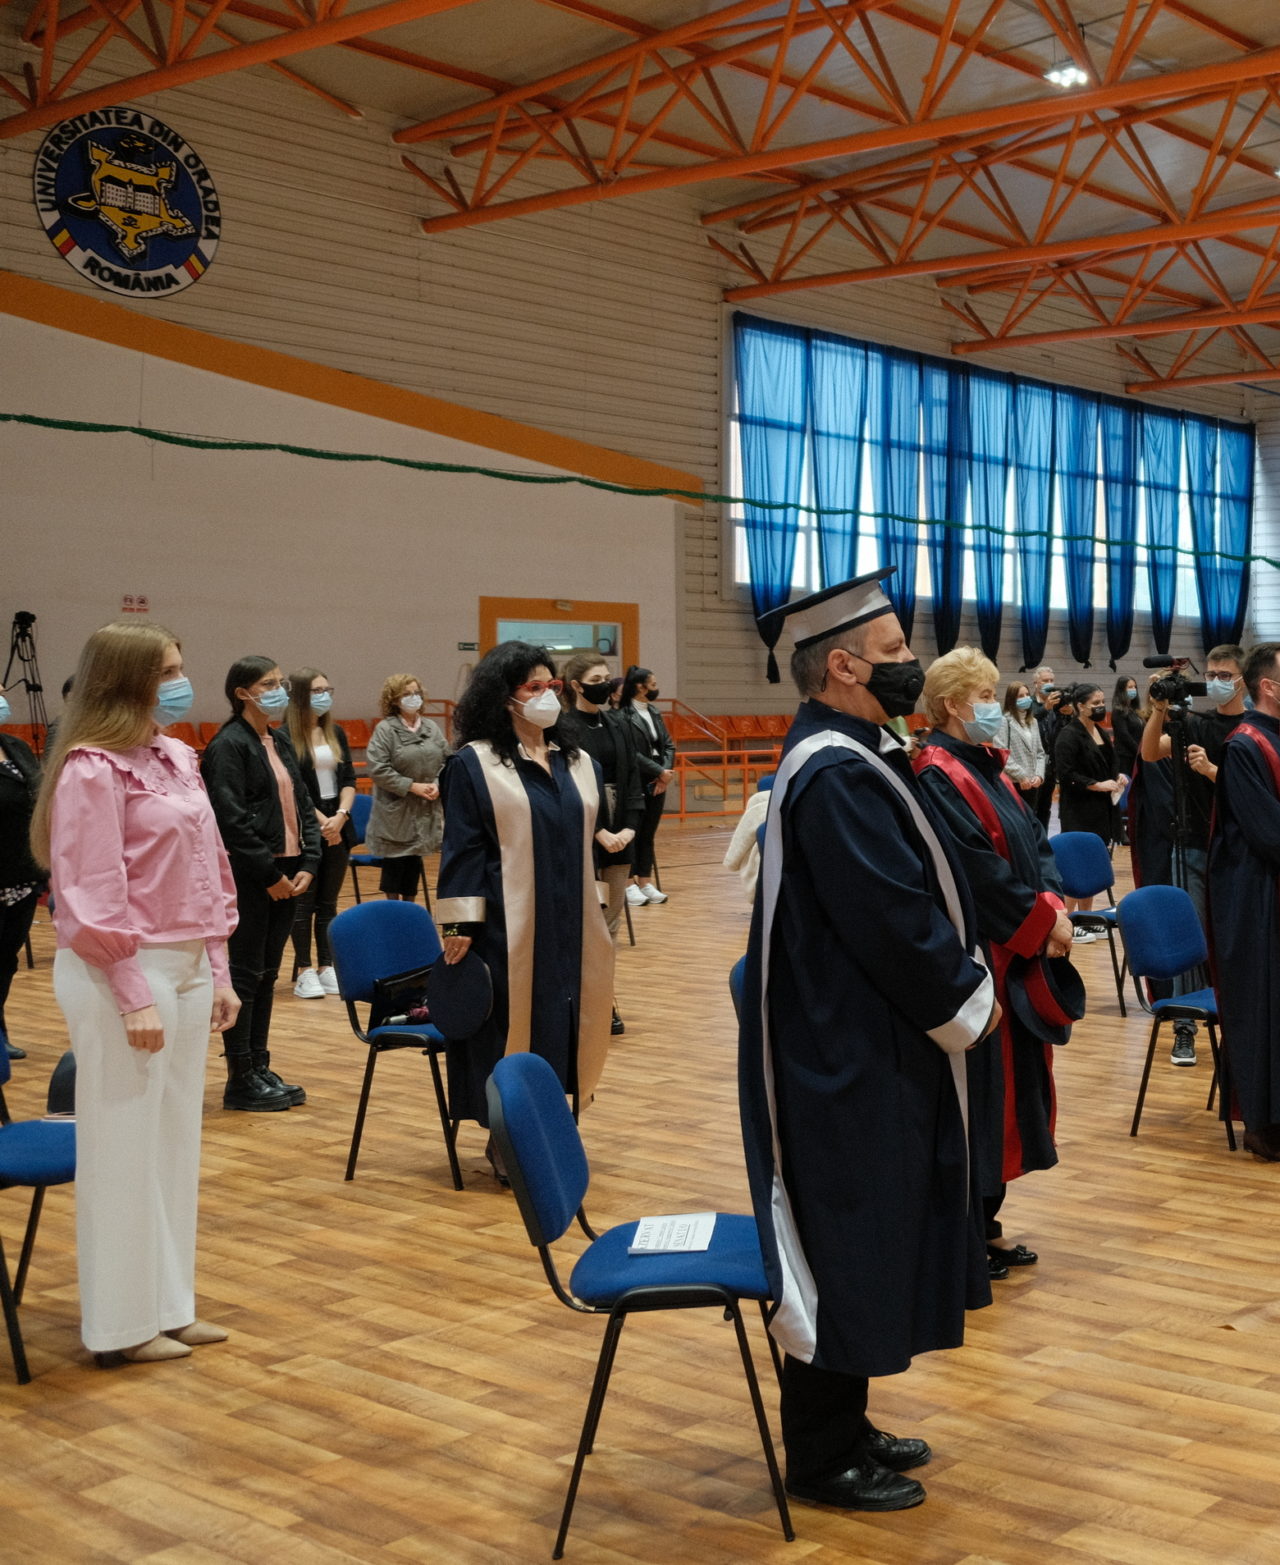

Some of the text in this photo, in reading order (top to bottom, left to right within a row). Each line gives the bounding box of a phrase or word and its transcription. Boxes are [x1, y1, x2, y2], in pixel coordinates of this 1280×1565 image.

[37, 109, 221, 240] UNIVERSITATEA DIN ORADEA
[83, 256, 181, 292] ROMÂNIA
